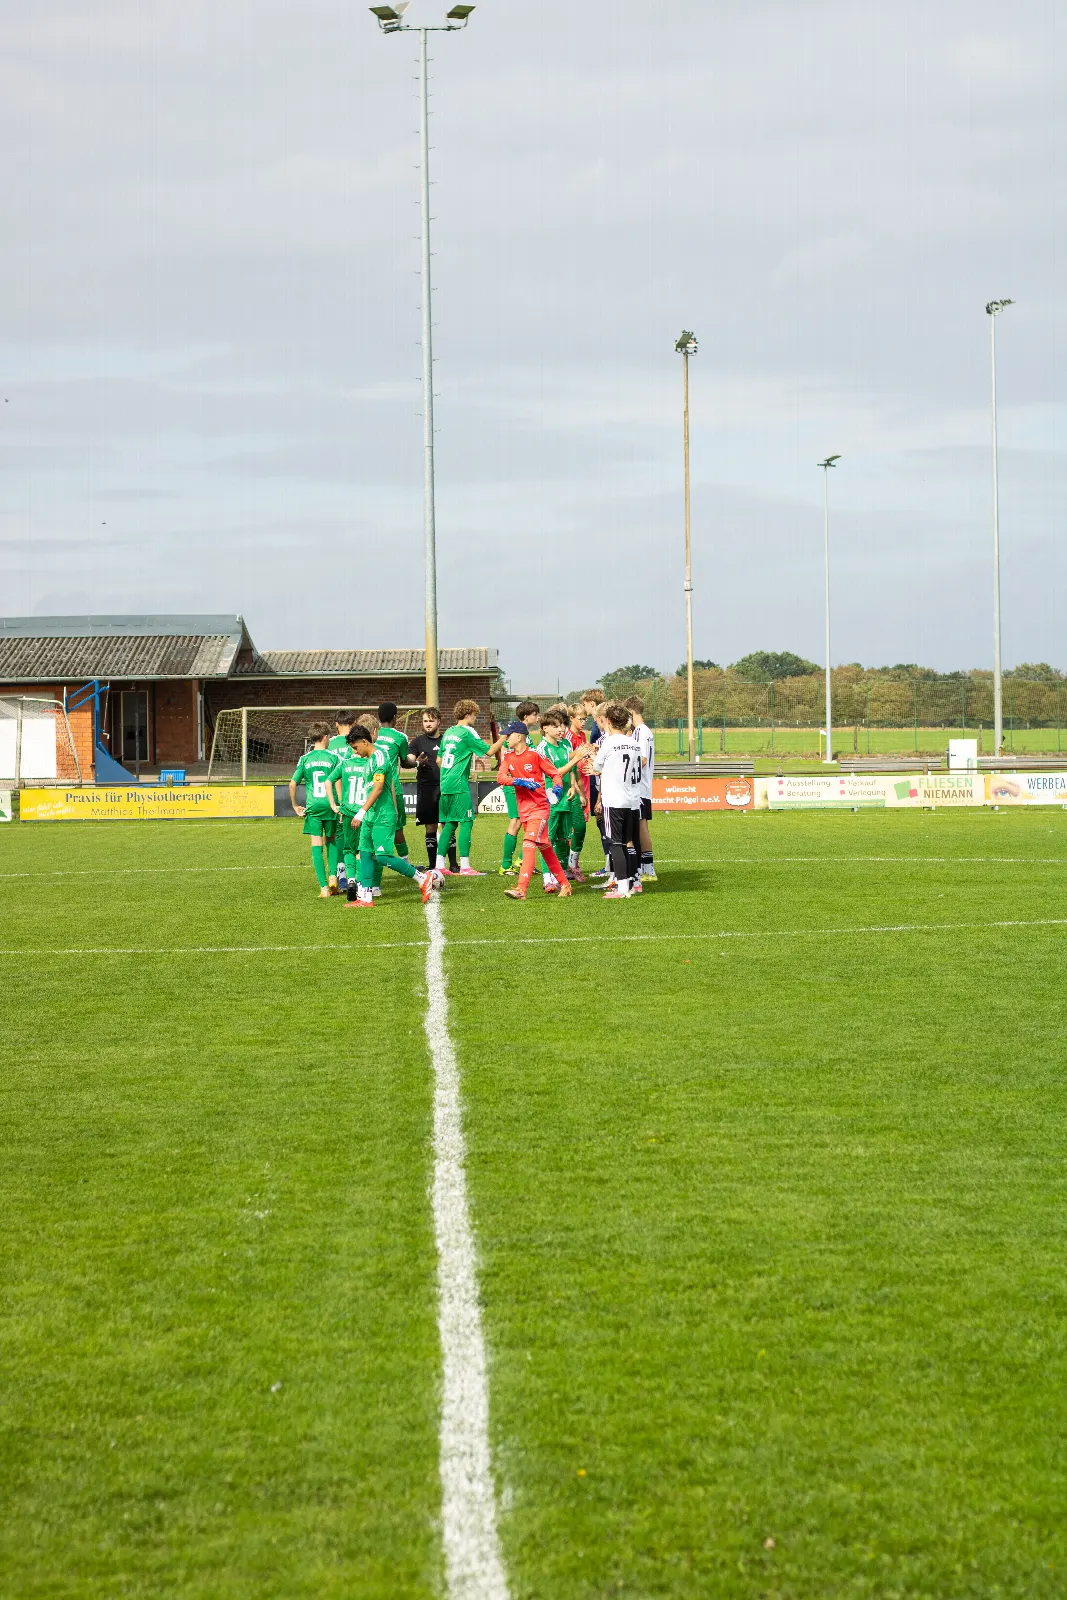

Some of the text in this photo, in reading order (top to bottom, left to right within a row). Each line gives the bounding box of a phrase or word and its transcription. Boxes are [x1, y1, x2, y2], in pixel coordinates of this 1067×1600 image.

[622, 754, 631, 783] 7
[312, 770, 327, 798] 6
[786, 779, 831, 787] Ausstellung
[918, 777, 974, 789] FLIESEN
[1027, 777, 1067, 790] WERBEA
[665, 785, 697, 793] wünscht
[786, 790, 821, 798] Beratung
[848, 789, 886, 797] Verlegung
[923, 789, 974, 799] NIEMANN
[65, 792, 101, 803] Praxis
[105, 791, 123, 803] für
[126, 789, 213, 805] Physiotherapie
[675, 795, 699, 805] Prügel
[700, 795, 721, 803] n.e.V.
[90, 806, 186, 816] Matthias Theilmann
[482, 804, 495, 812] Tel.
